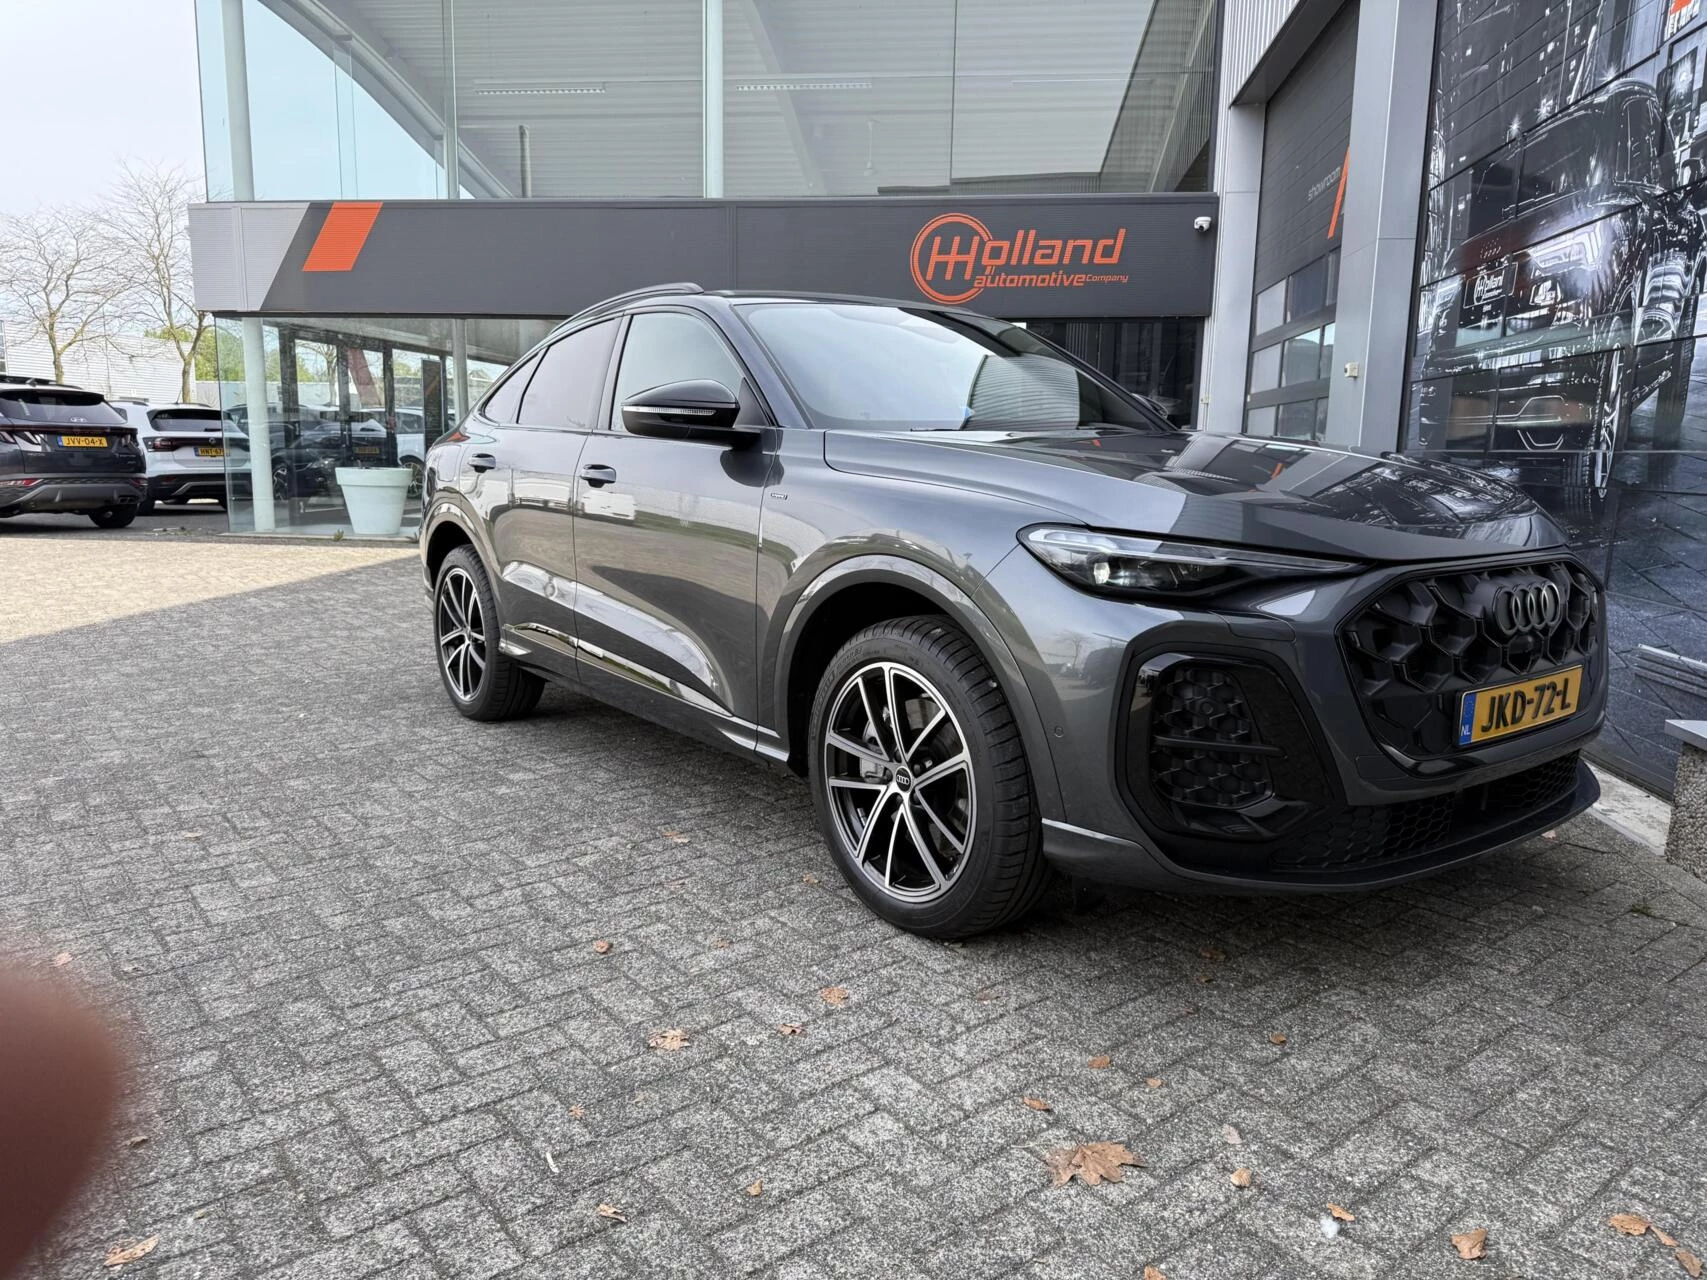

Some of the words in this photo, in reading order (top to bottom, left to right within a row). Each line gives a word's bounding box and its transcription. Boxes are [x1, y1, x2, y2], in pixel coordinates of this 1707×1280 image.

[973, 270, 1086, 288] automotive
[1086, 273, 1129, 284] Company
[1481, 678, 1571, 732] JKD-72-L
[1460, 724, 1471, 736] NL
